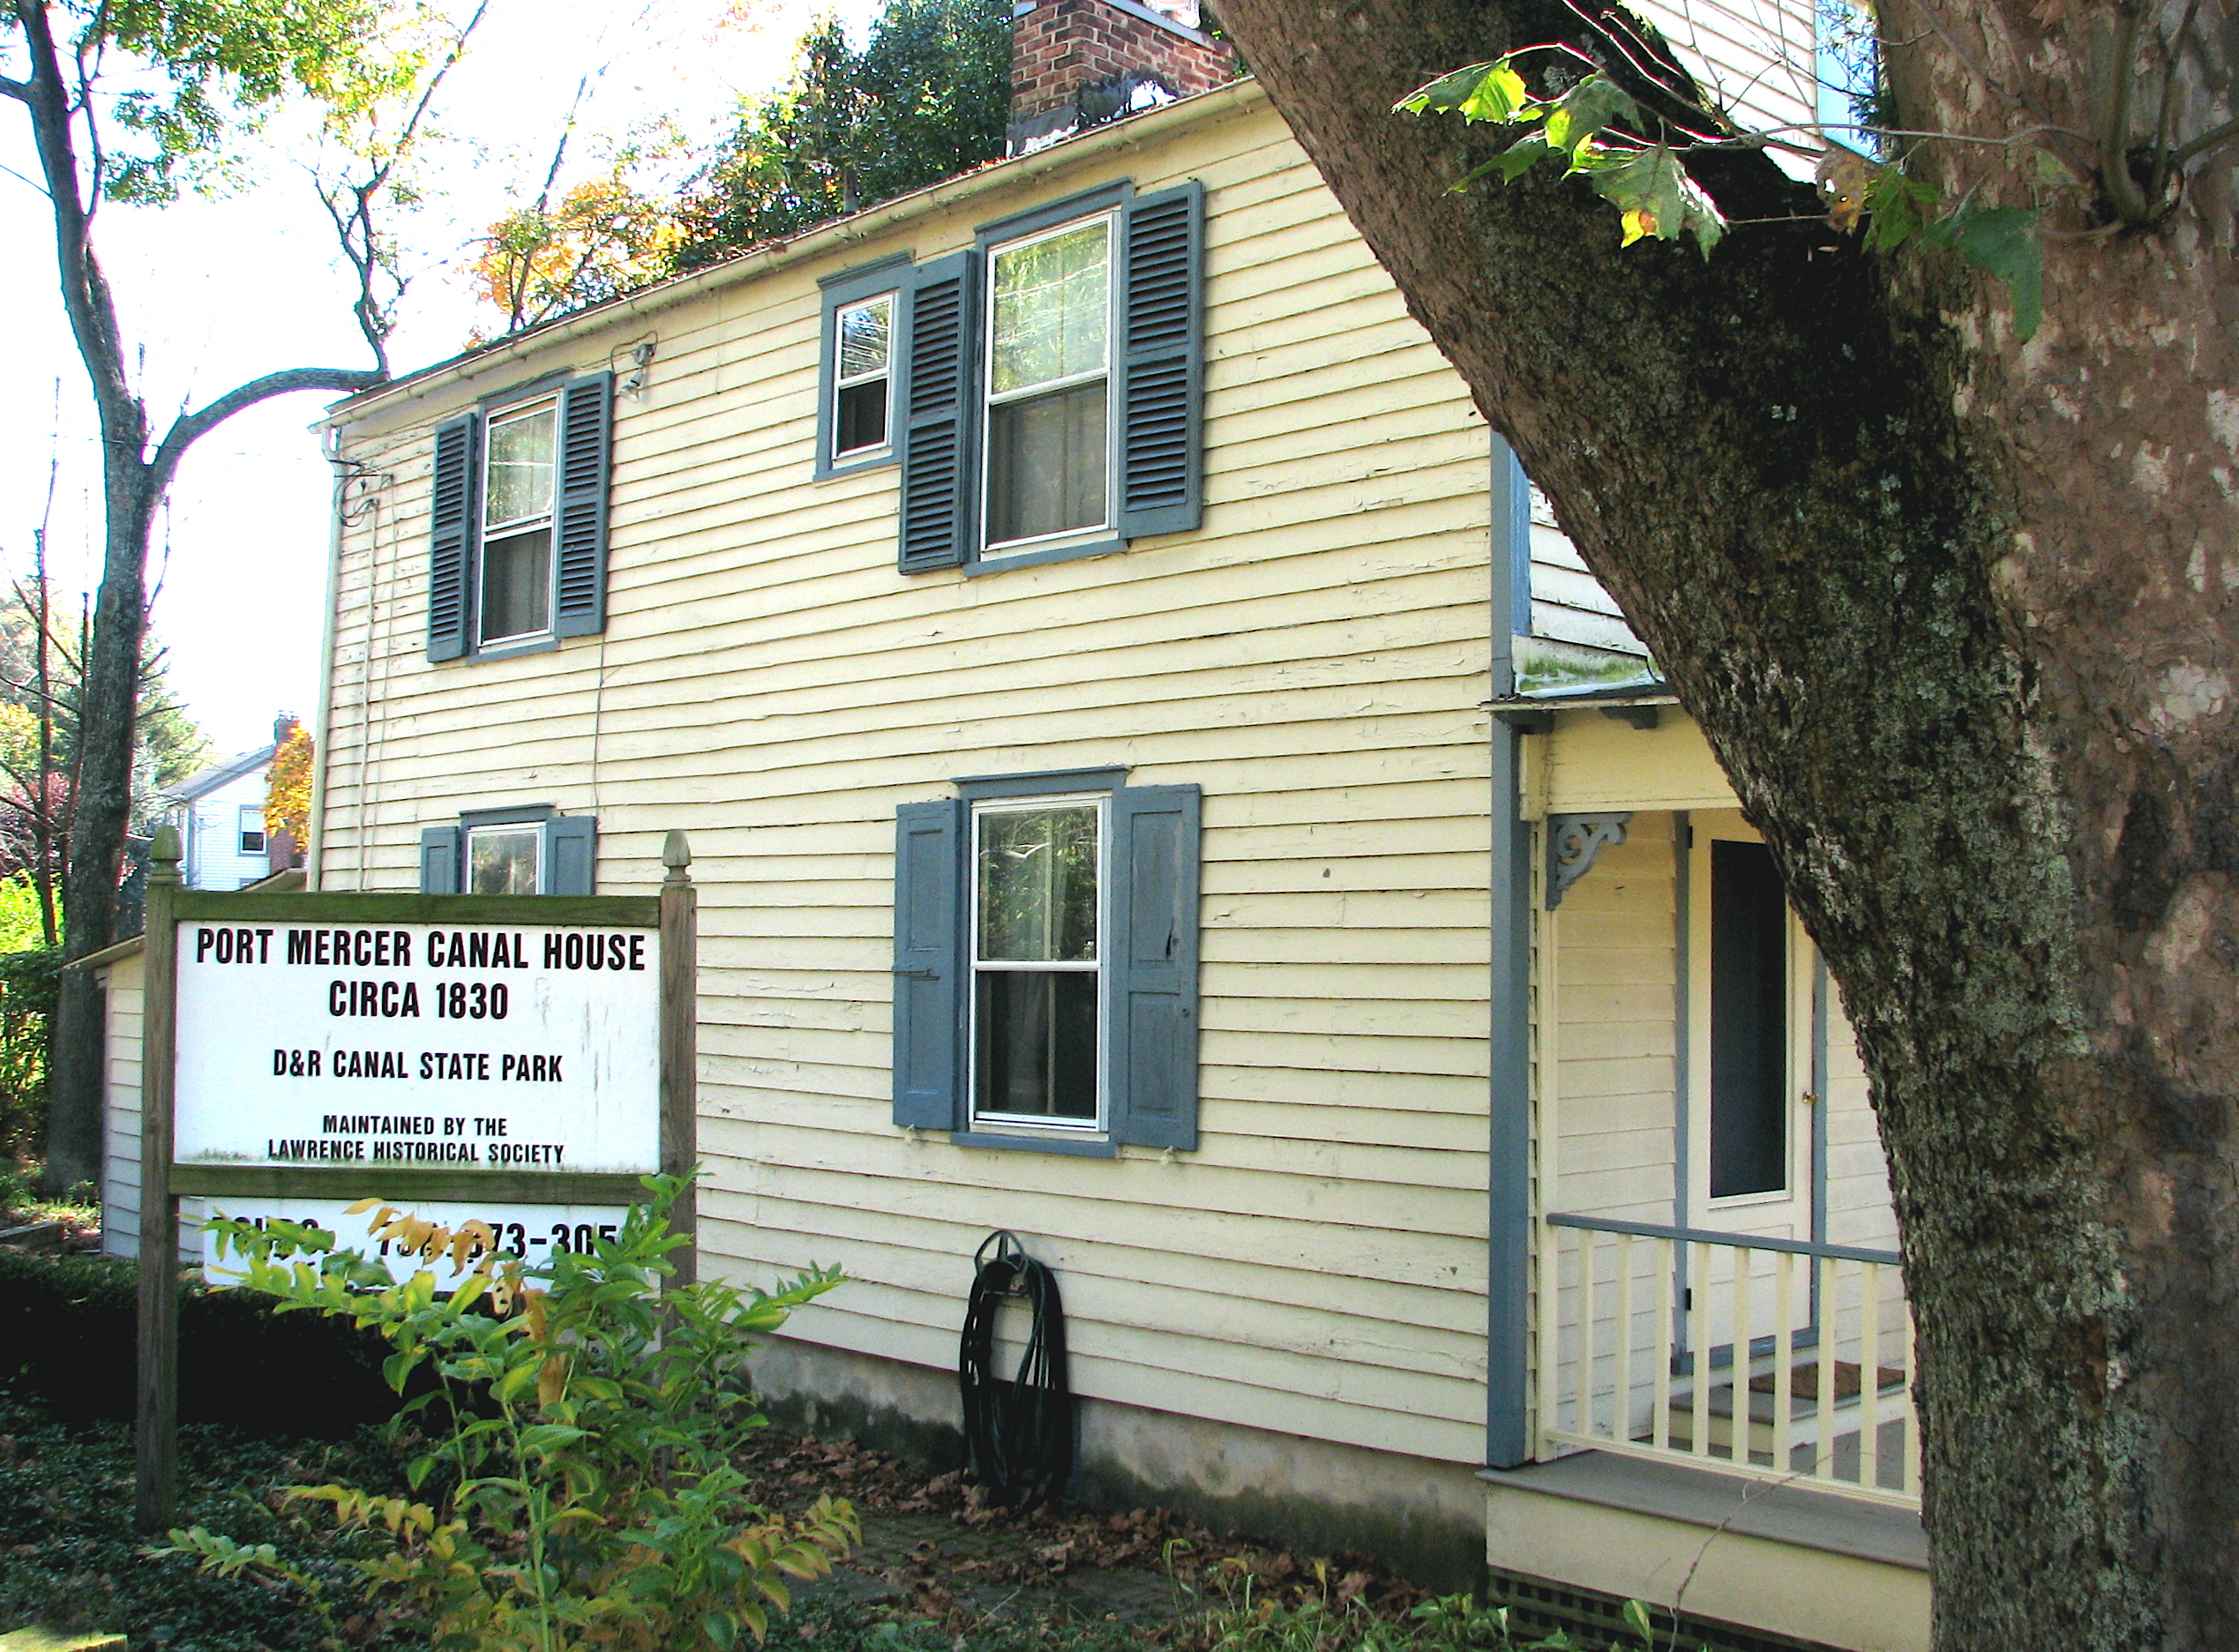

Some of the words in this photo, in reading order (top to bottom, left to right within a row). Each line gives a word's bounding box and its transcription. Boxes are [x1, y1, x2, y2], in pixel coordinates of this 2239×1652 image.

[197, 927, 273, 965] PORT
[288, 929, 411, 967] MERCER
[427, 931, 528, 969] CANAL
[543, 933, 646, 971] HOUSE
[329, 980, 420, 1018] CIRCA
[436, 982, 509, 1020] 1830
[273, 1049, 321, 1077] D&R
[333, 1050, 408, 1079] CANAL
[419, 1051, 490, 1080] STATE
[502, 1054, 563, 1082] PARK
[323, 1115, 435, 1135] MAINTAINED
[444, 1117, 467, 1136] BY
[474, 1118, 507, 1137] THE
[268, 1139, 364, 1161] LAWRENCE
[373, 1141, 479, 1162] HISTORICAL
[488, 1143, 565, 1164] SOCIETY
